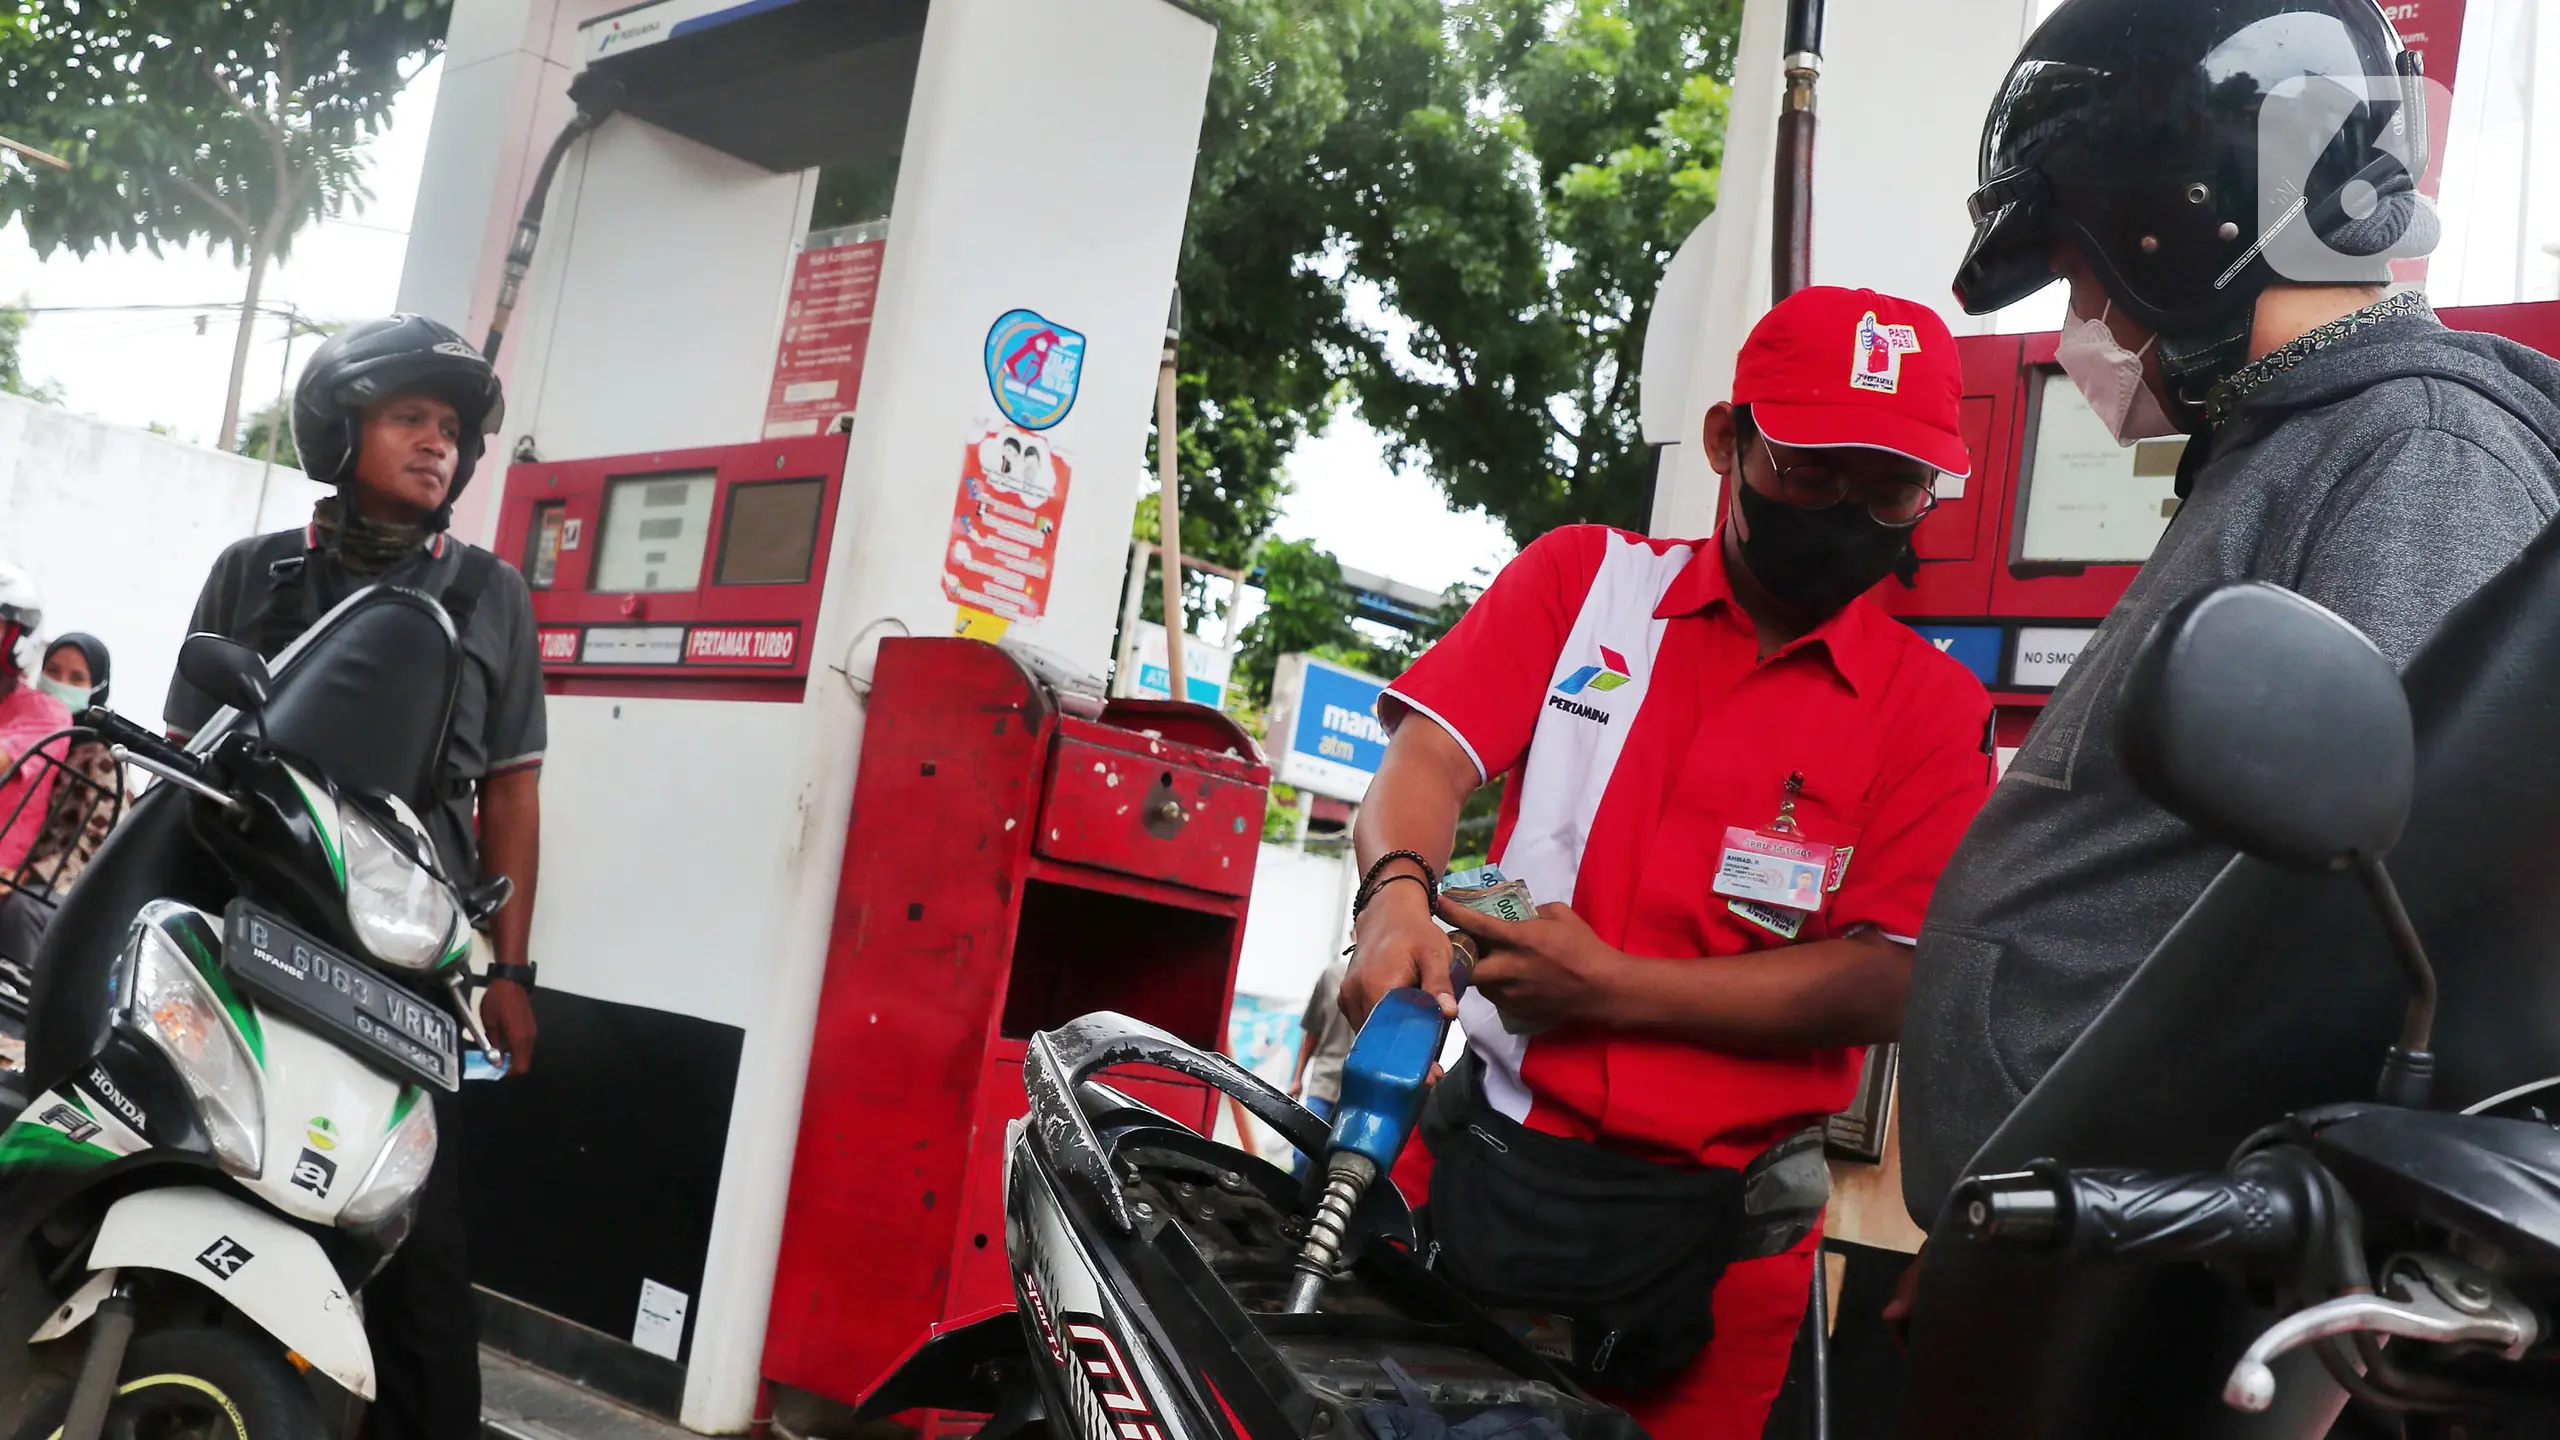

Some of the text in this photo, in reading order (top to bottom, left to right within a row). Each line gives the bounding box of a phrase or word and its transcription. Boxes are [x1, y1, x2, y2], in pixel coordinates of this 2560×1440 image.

[2384, 3, 2420, 20] en:
[541, 632, 577, 658] TURBO
[691, 629, 793, 659] PERTAMAX TURBO
[2024, 651, 2077, 665] NO SMO
[1548, 694, 1610, 726] PERTAMINA
[1318, 734, 1354, 762] atm
[249, 920, 269, 950] B
[386, 992, 445, 1050] VRM
[89, 1066, 147, 1131] HONDA
